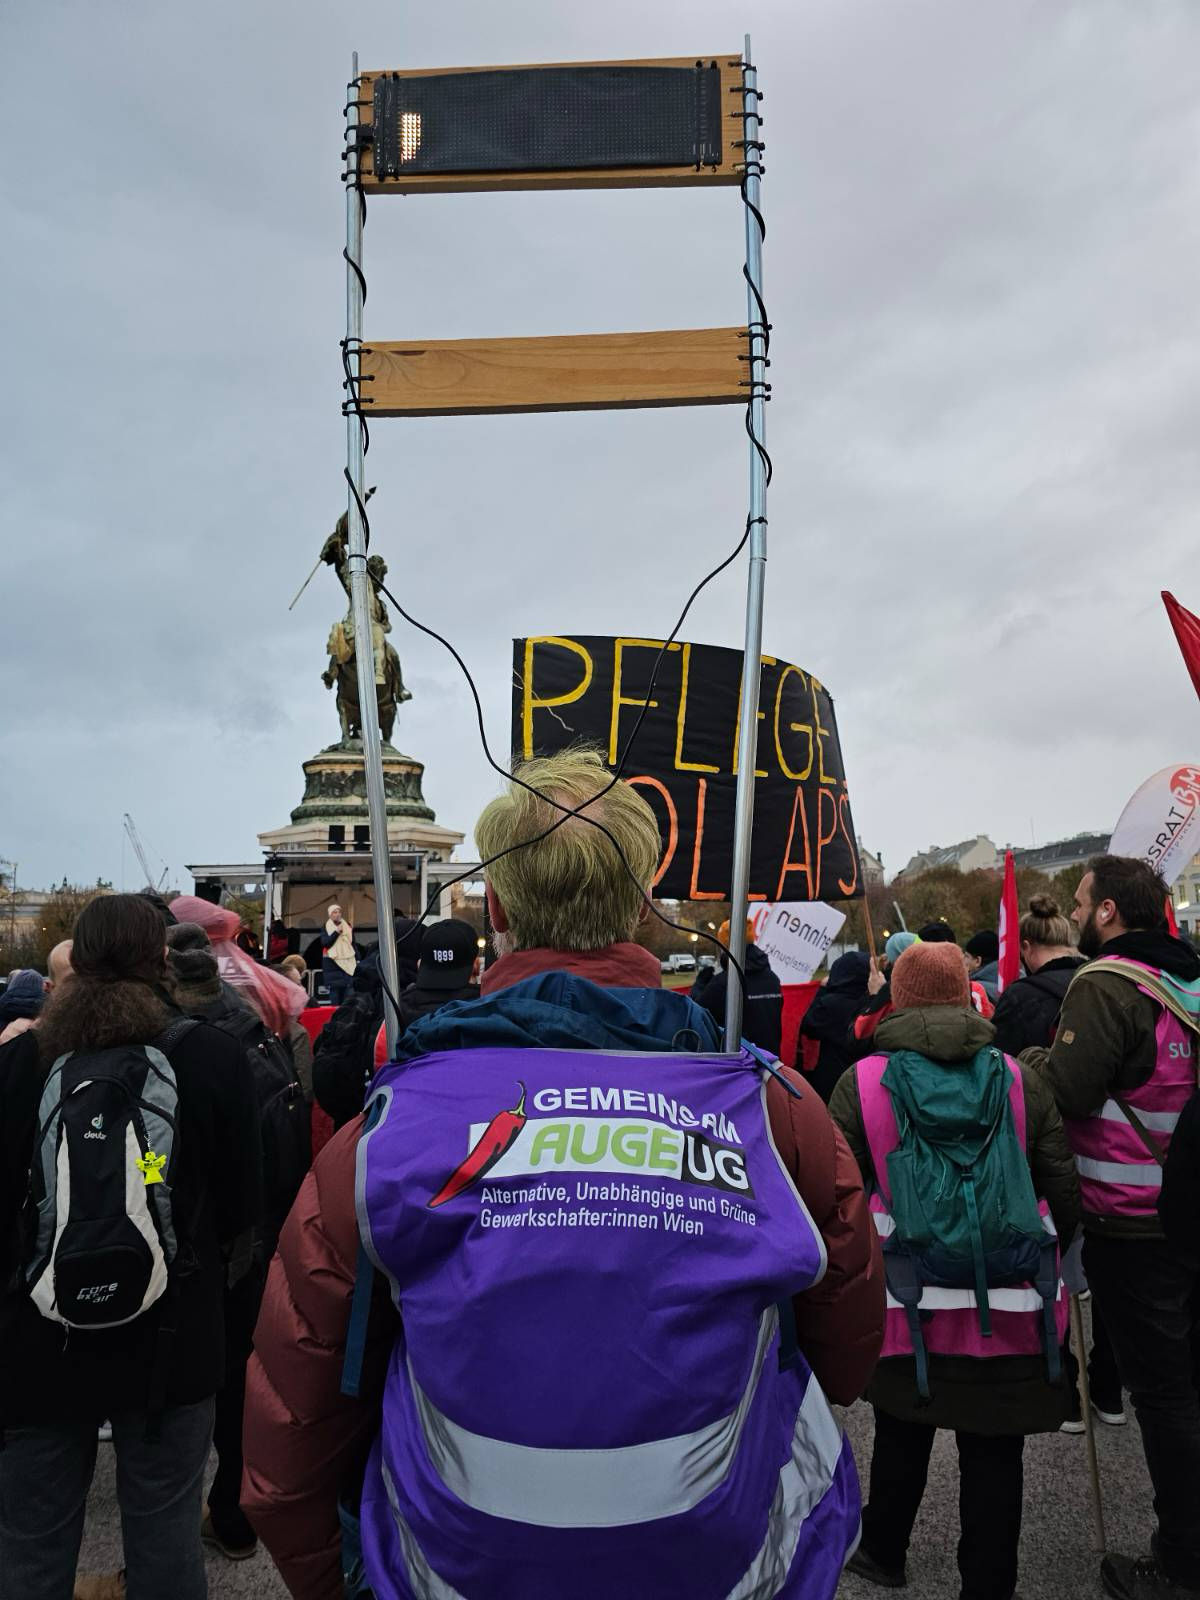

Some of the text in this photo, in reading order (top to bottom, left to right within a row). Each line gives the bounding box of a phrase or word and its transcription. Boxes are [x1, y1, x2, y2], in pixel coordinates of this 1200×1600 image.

[521, 635, 837, 785] PFLEGE
[433, 949, 454, 962] 1899
[533, 1086, 743, 1145] GEMEINSAM
[480, 1182, 757, 1227] Alternative, Unabhängige und Grüne
[480, 1206, 704, 1236] Gewerkschafter:innen Wien
